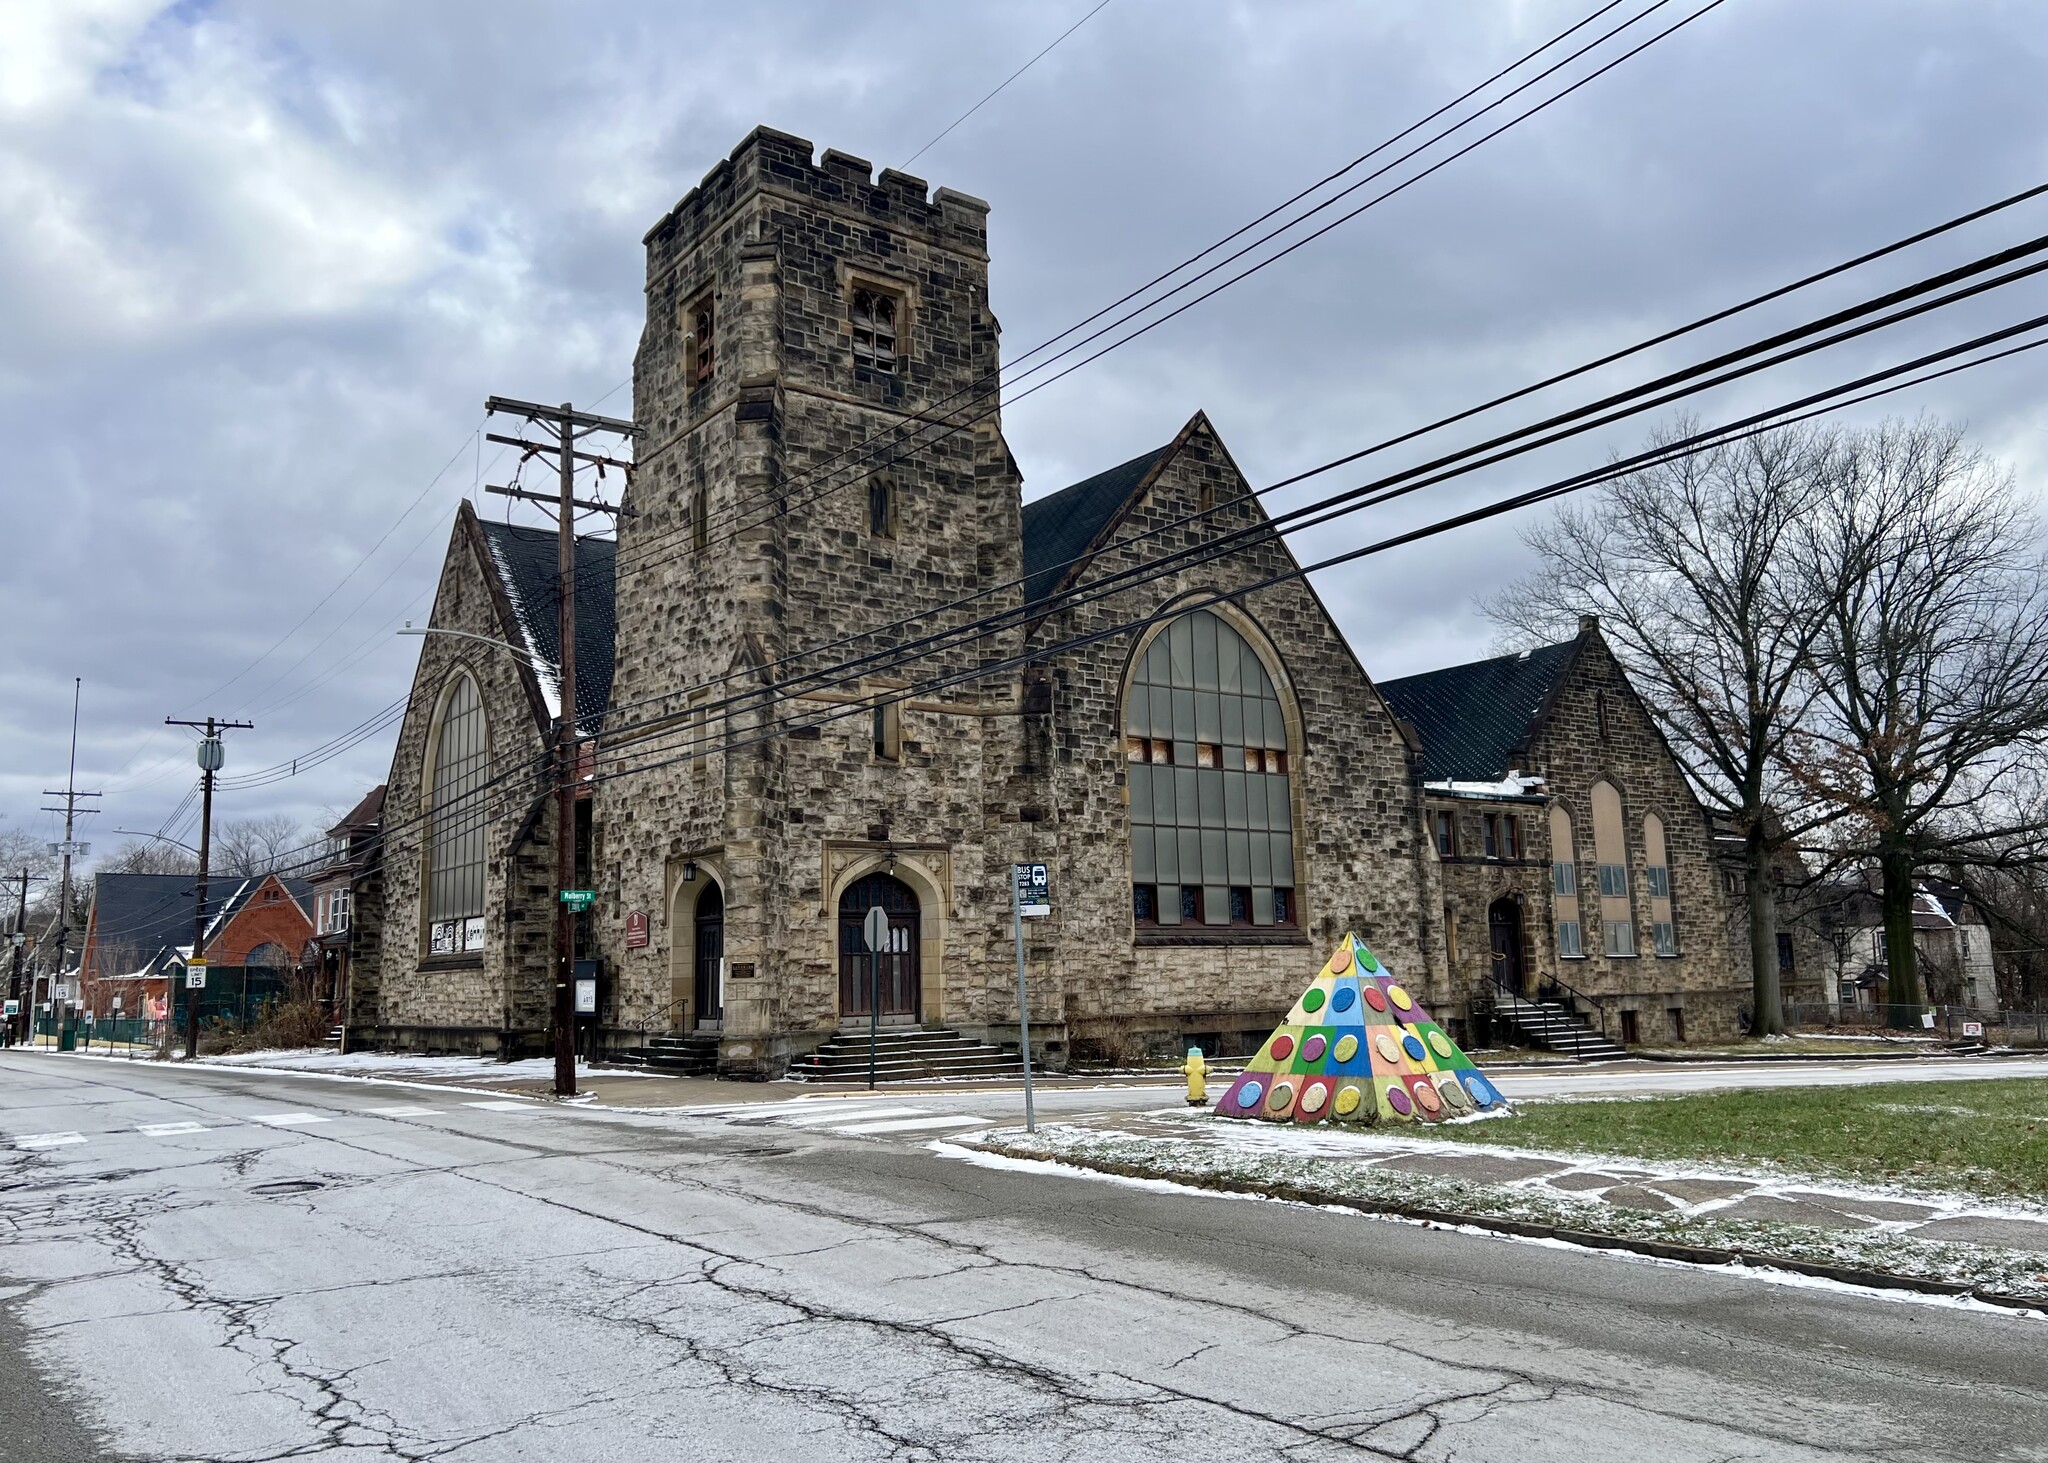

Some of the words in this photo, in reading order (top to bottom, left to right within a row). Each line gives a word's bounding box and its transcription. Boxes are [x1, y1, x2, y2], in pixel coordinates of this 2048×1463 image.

[1017, 866, 1030, 874] BUS
[564, 892, 586, 901] Mulberry
[586, 892, 592, 900] St
[191, 977, 202, 986] 15
